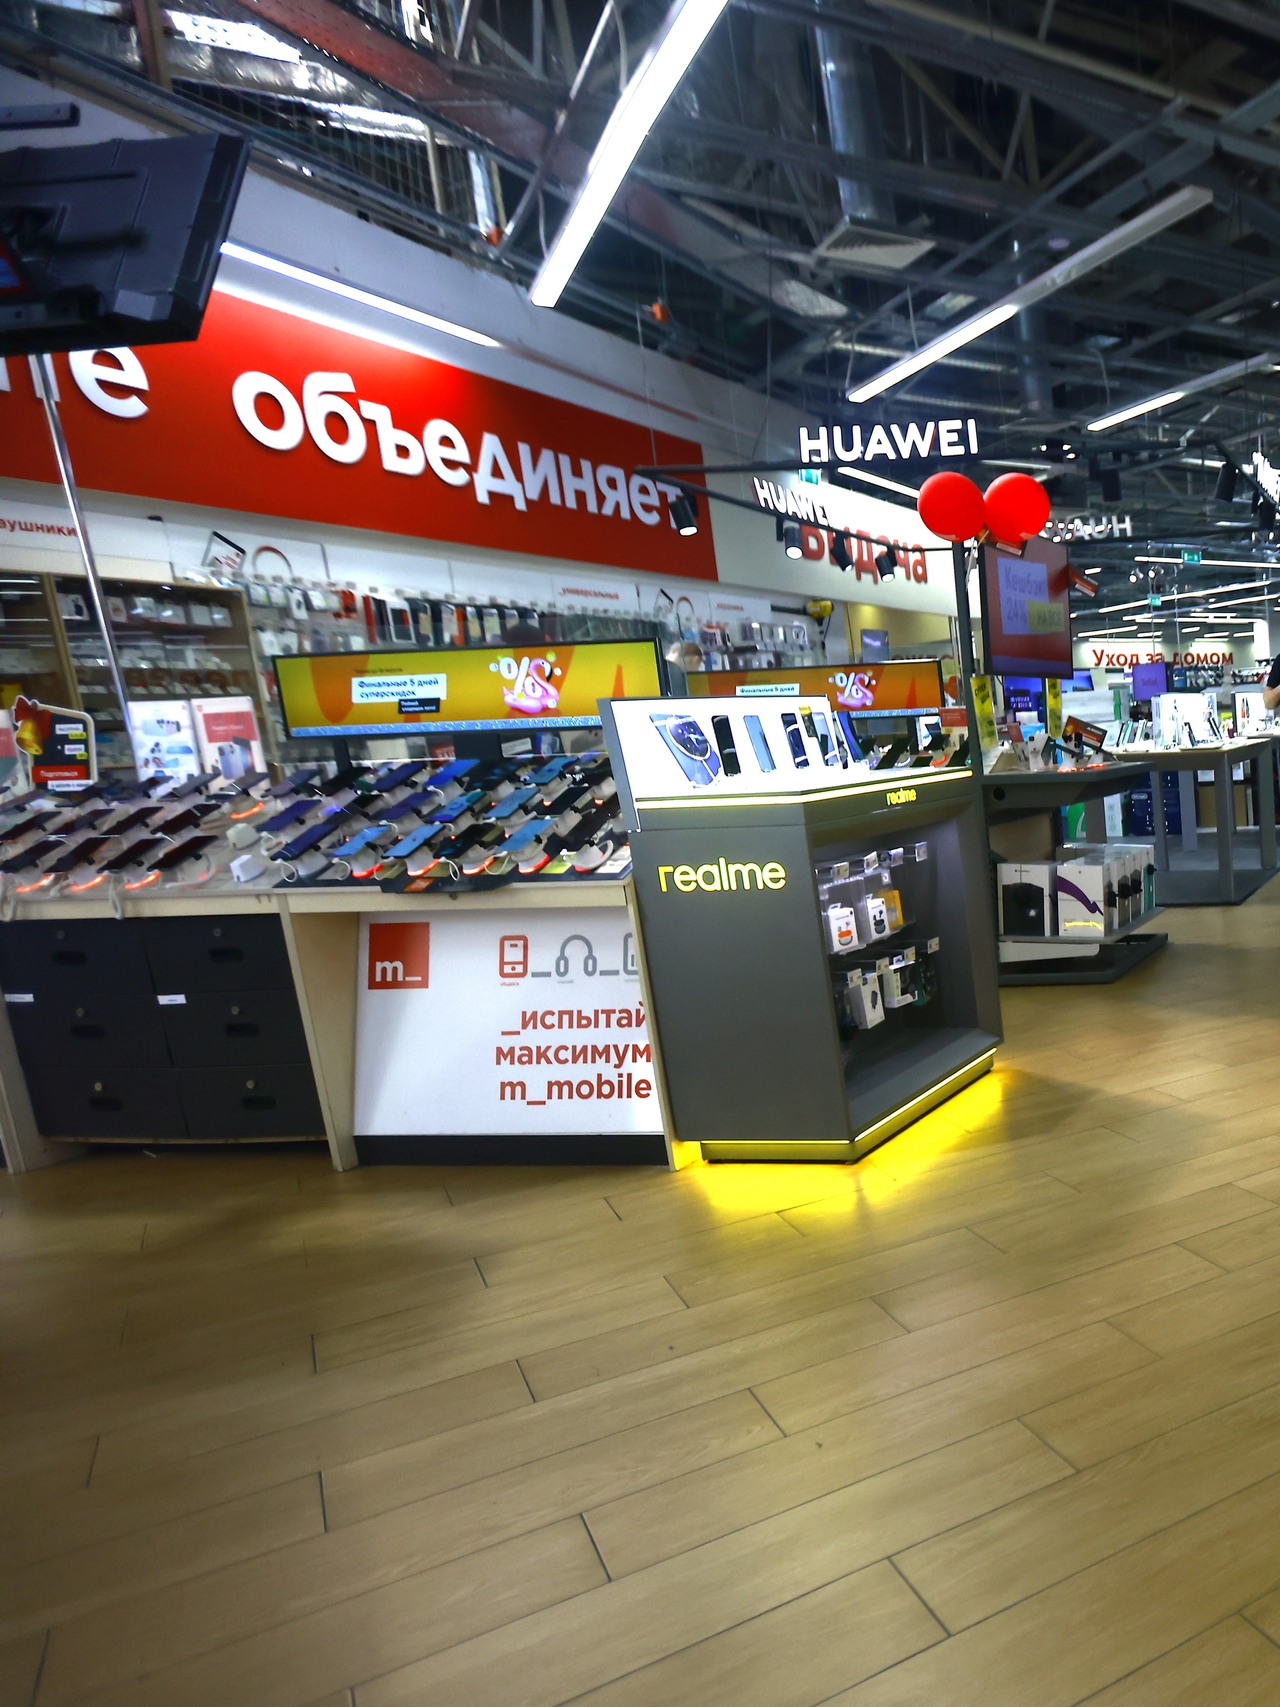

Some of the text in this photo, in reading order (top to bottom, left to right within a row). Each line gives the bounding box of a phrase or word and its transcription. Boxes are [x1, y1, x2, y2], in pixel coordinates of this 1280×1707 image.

[232, 371, 686, 529] объединяет
[799, 419, 979, 463] HUAWEI
[753, 476, 831, 527] HUAWE
[1092, 649, 1234, 669] Уход за домом
[357, 680, 408, 689] Финальные
[417, 677, 439, 688] дней
[886, 787, 917, 806] realme
[657, 856, 787, 893] realme
[495, 1042, 652, 1069] максимум
[500, 1072, 653, 1106] m_mobile
